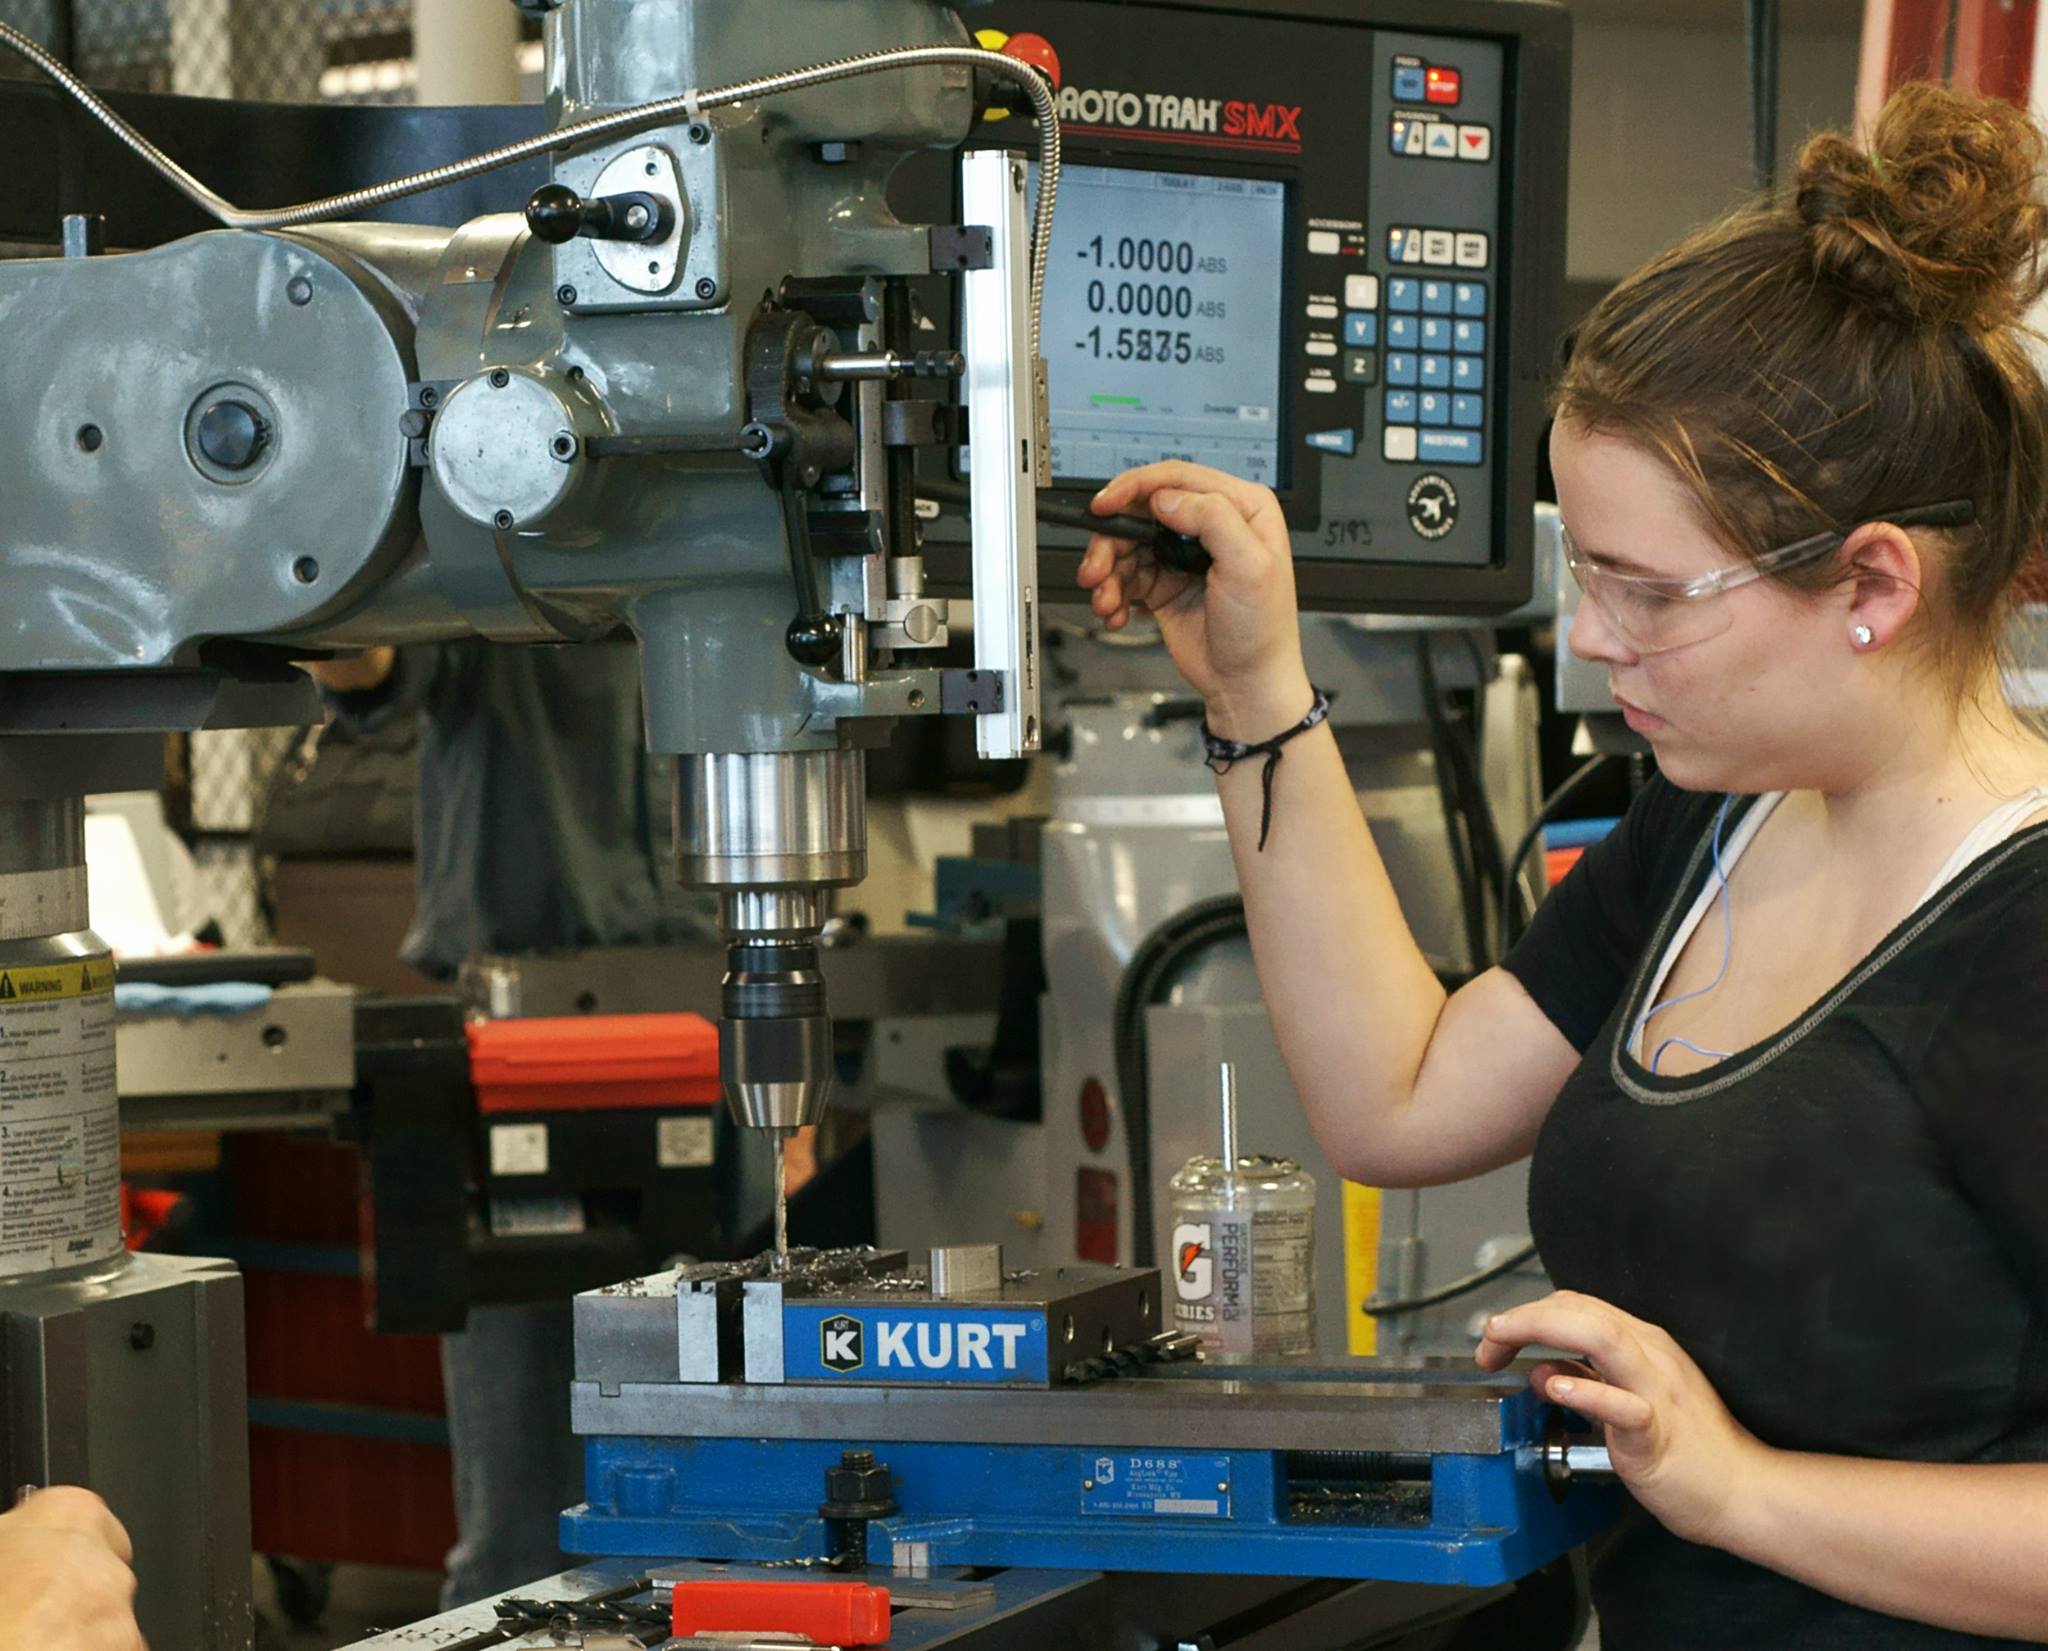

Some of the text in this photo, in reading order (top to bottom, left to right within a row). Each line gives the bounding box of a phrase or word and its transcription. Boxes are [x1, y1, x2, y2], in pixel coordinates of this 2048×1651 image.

[1427, 82, 1458, 92] STOP
[1033, 86, 1142, 127] ROTO
[1222, 101, 1301, 139] SMX
[1077, 235, 1228, 274] -1.0000 ABS
[1088, 280, 1226, 319] 0.0000 ABS
[1354, 320, 1367, 337] Y
[1195, 347, 1225, 364] ABS
[1353, 358, 1366, 375] Z
[1423, 358, 1437, 375] 2
[1423, 395, 1436, 411] 0
[19, 979, 62, 995] WARNING
[826, 1322, 1026, 1369] K KURT
